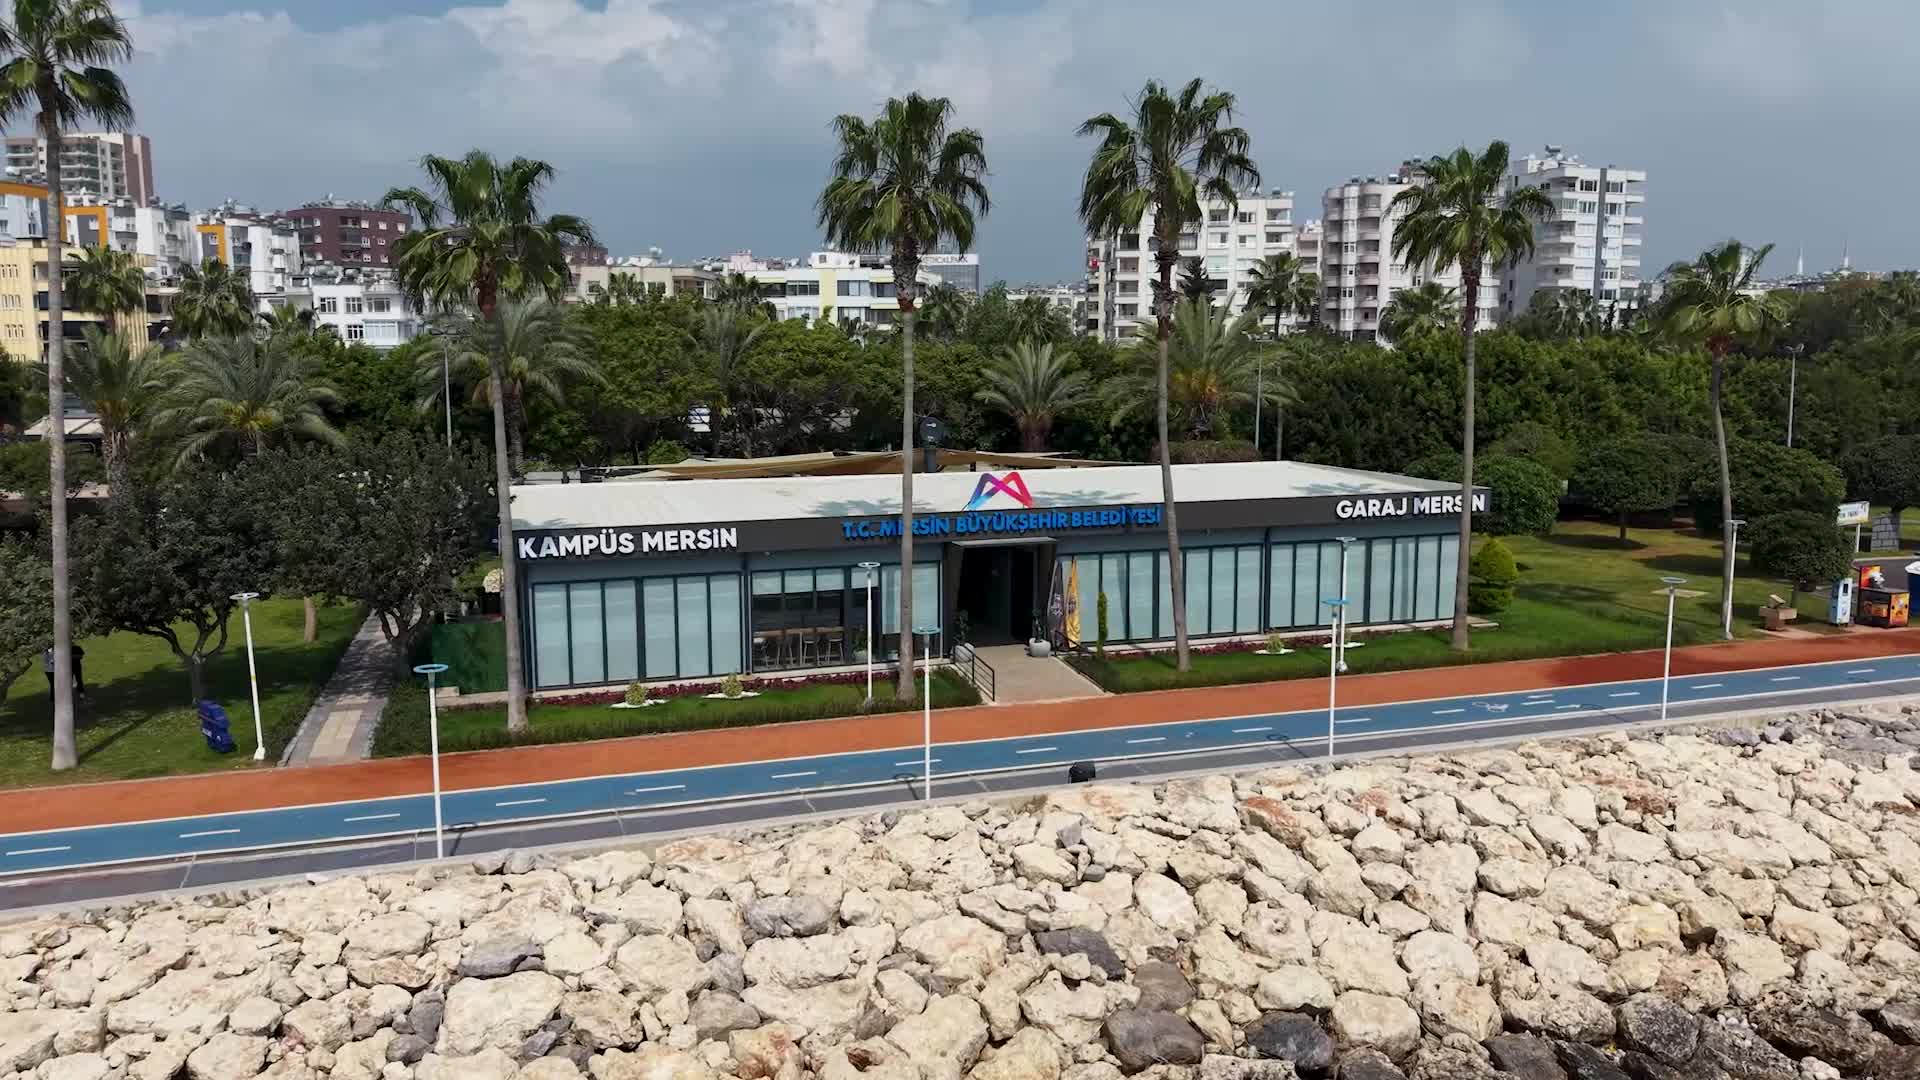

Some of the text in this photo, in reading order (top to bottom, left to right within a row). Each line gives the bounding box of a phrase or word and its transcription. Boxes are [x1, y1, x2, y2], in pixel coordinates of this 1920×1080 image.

[842, 519, 873, 538] T.C.
[956, 509, 1068, 534] BÜYÜKŞEHİR
[1071, 505, 1161, 528] BELEDİYESİ
[1336, 494, 1486, 519] GARAJ MERSN
[518, 528, 635, 559] KAMPÜS
